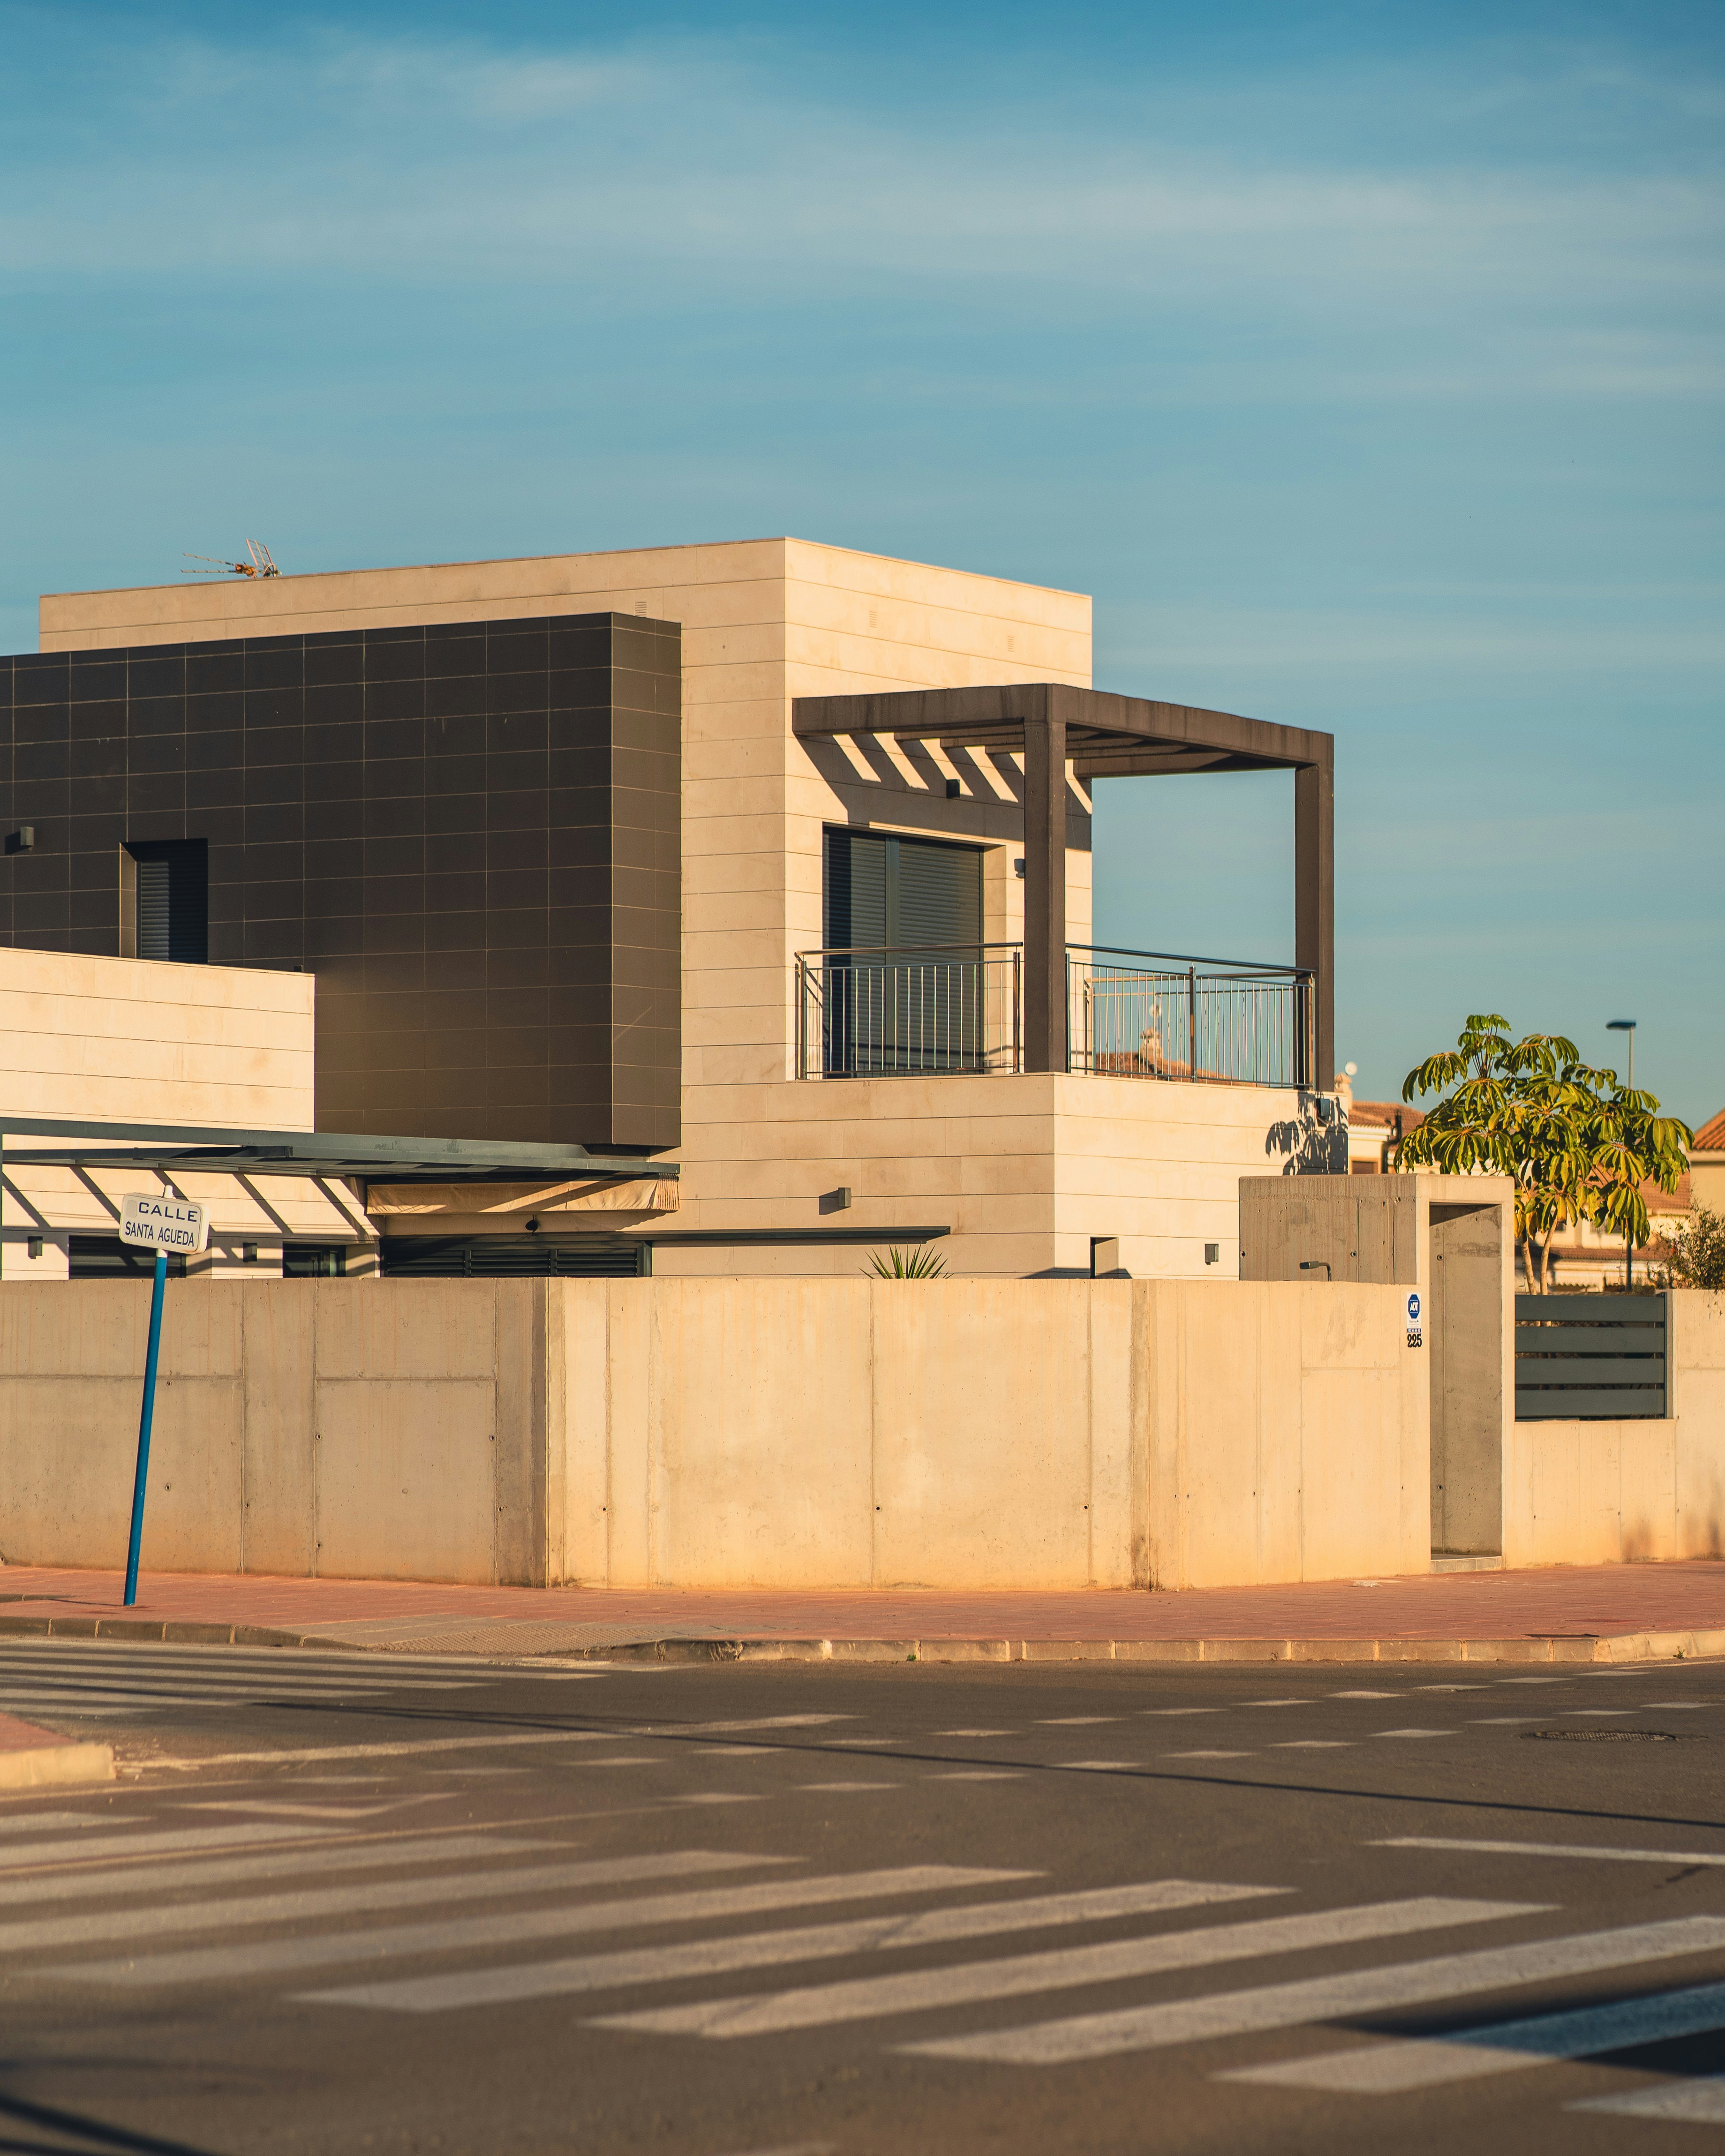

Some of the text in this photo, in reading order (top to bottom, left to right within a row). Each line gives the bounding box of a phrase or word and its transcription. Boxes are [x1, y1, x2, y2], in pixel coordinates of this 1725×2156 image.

[138, 1202, 198, 1222] CALLE
[125, 1221, 195, 1247] SANTA AGUEDA
[1409, 1302, 1418, 1311] ADT
[1407, 1333, 1422, 1348] 225
